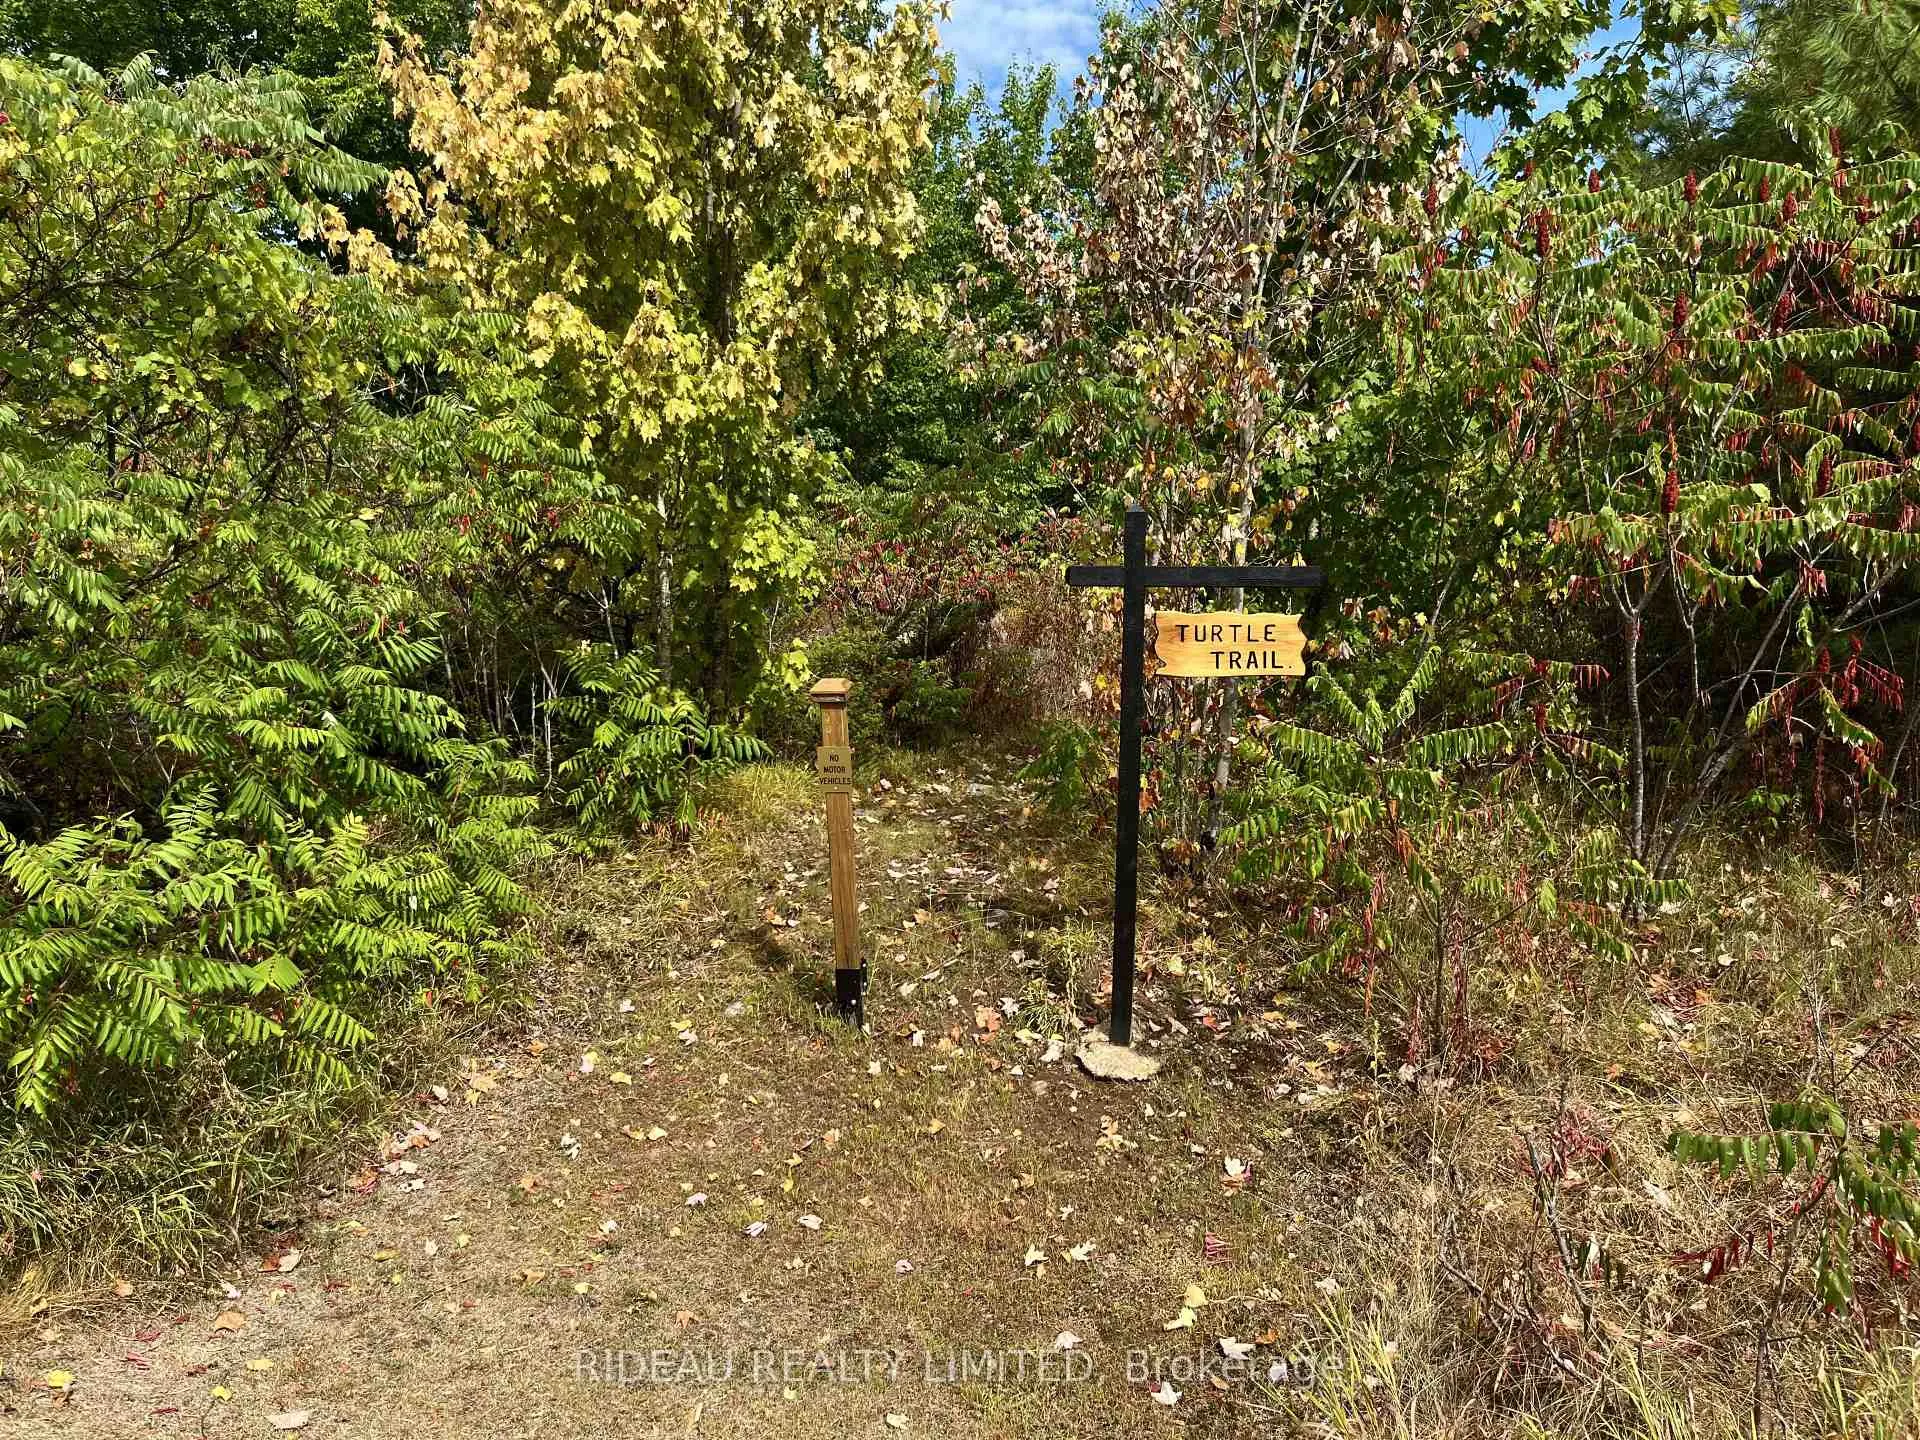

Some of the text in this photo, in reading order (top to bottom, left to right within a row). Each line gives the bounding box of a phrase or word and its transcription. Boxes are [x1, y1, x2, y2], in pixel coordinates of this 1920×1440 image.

[1175, 624, 1276, 643] TURTLE
[1210, 651, 1293, 670] TRAIL.
[829, 754, 840, 762] NO
[823, 766, 846, 774] MOTOR
[819, 777, 852, 785] VEHICLES
